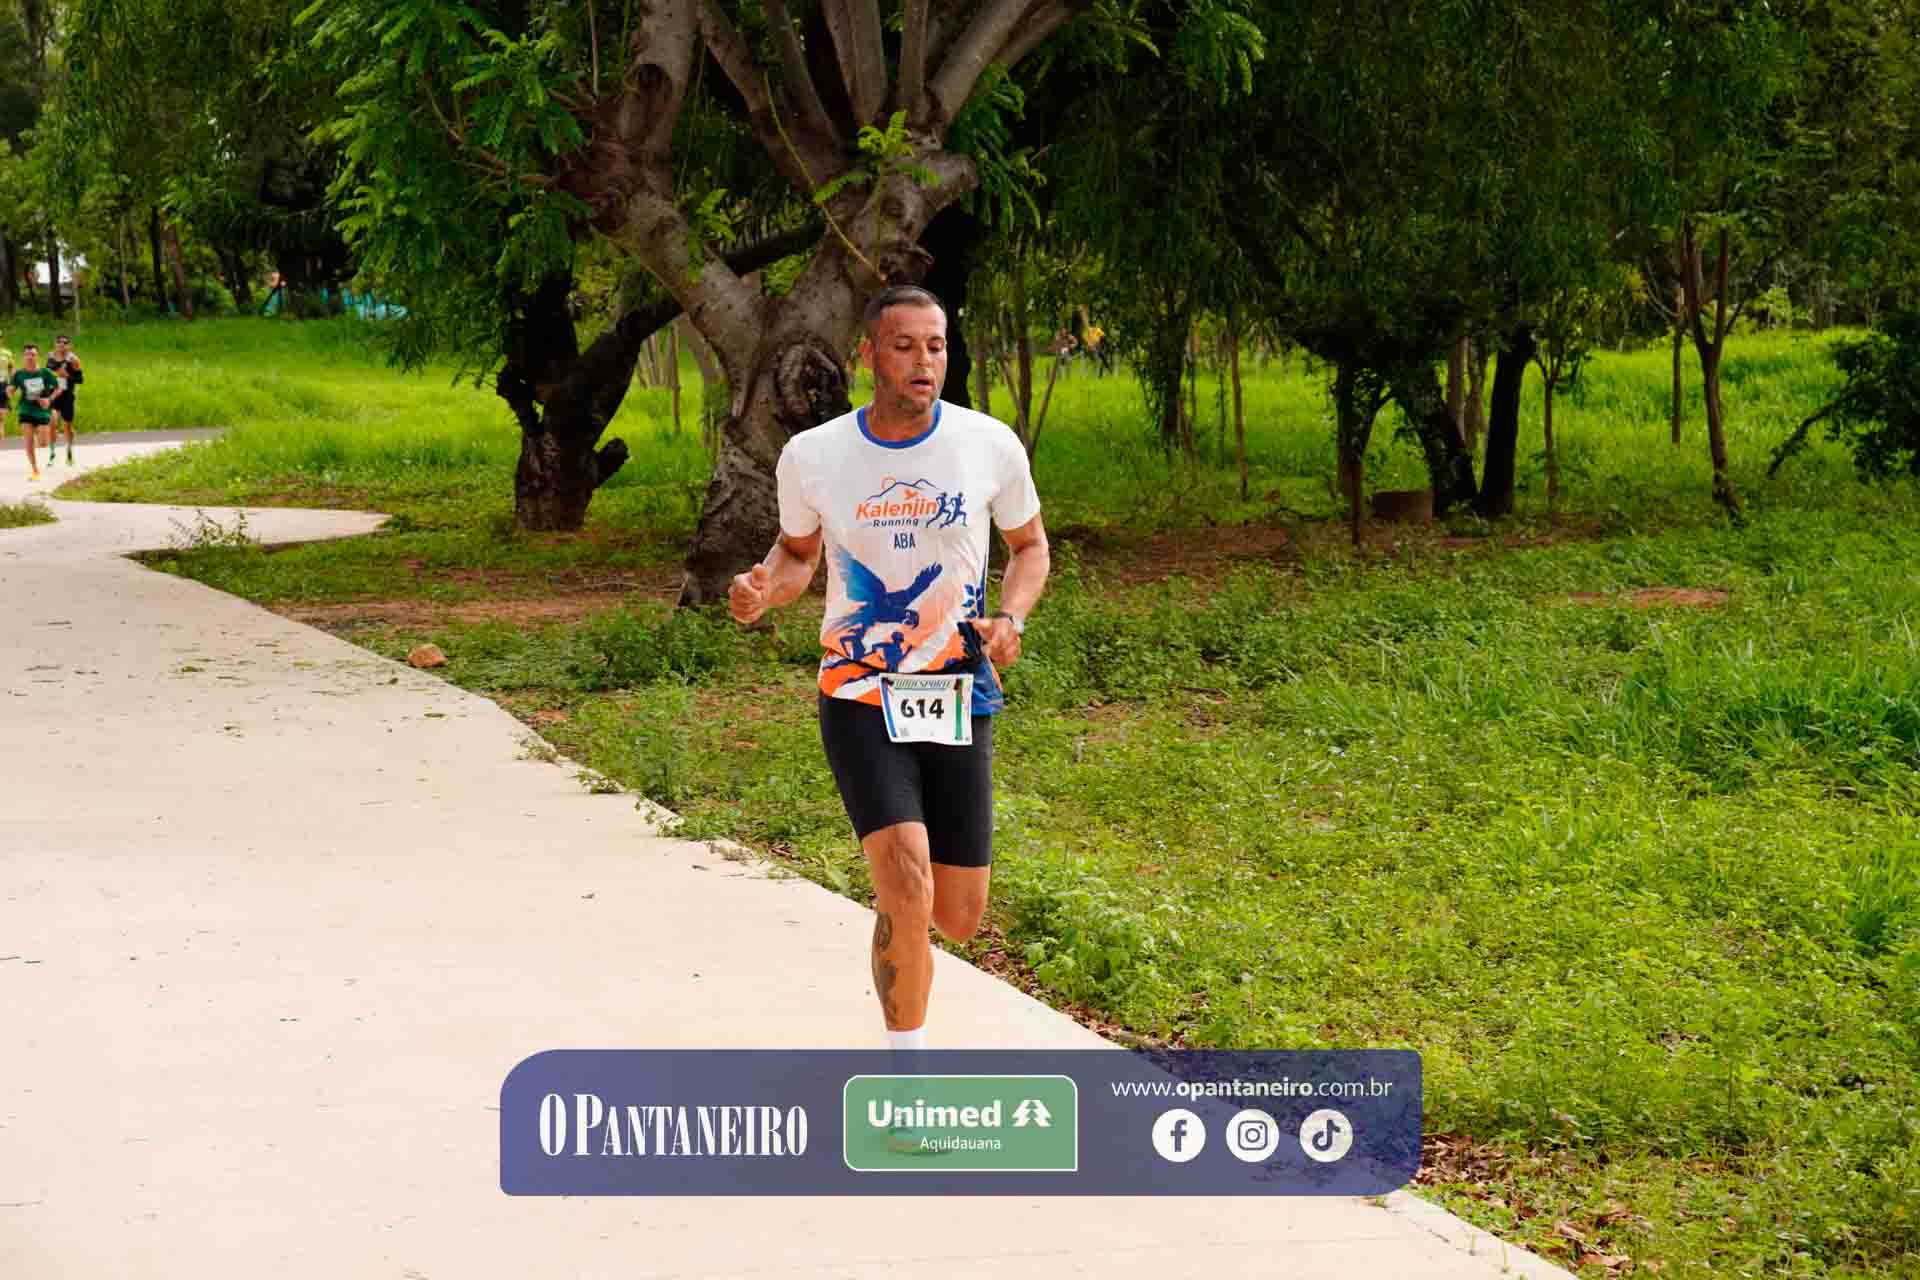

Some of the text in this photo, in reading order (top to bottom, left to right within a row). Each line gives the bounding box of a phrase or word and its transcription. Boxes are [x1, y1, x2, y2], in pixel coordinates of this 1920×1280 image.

[856, 499, 937, 519] Kalenjin
[873, 518, 919, 528] Running
[894, 532, 916, 549] ABA
[900, 698, 945, 719] 614
